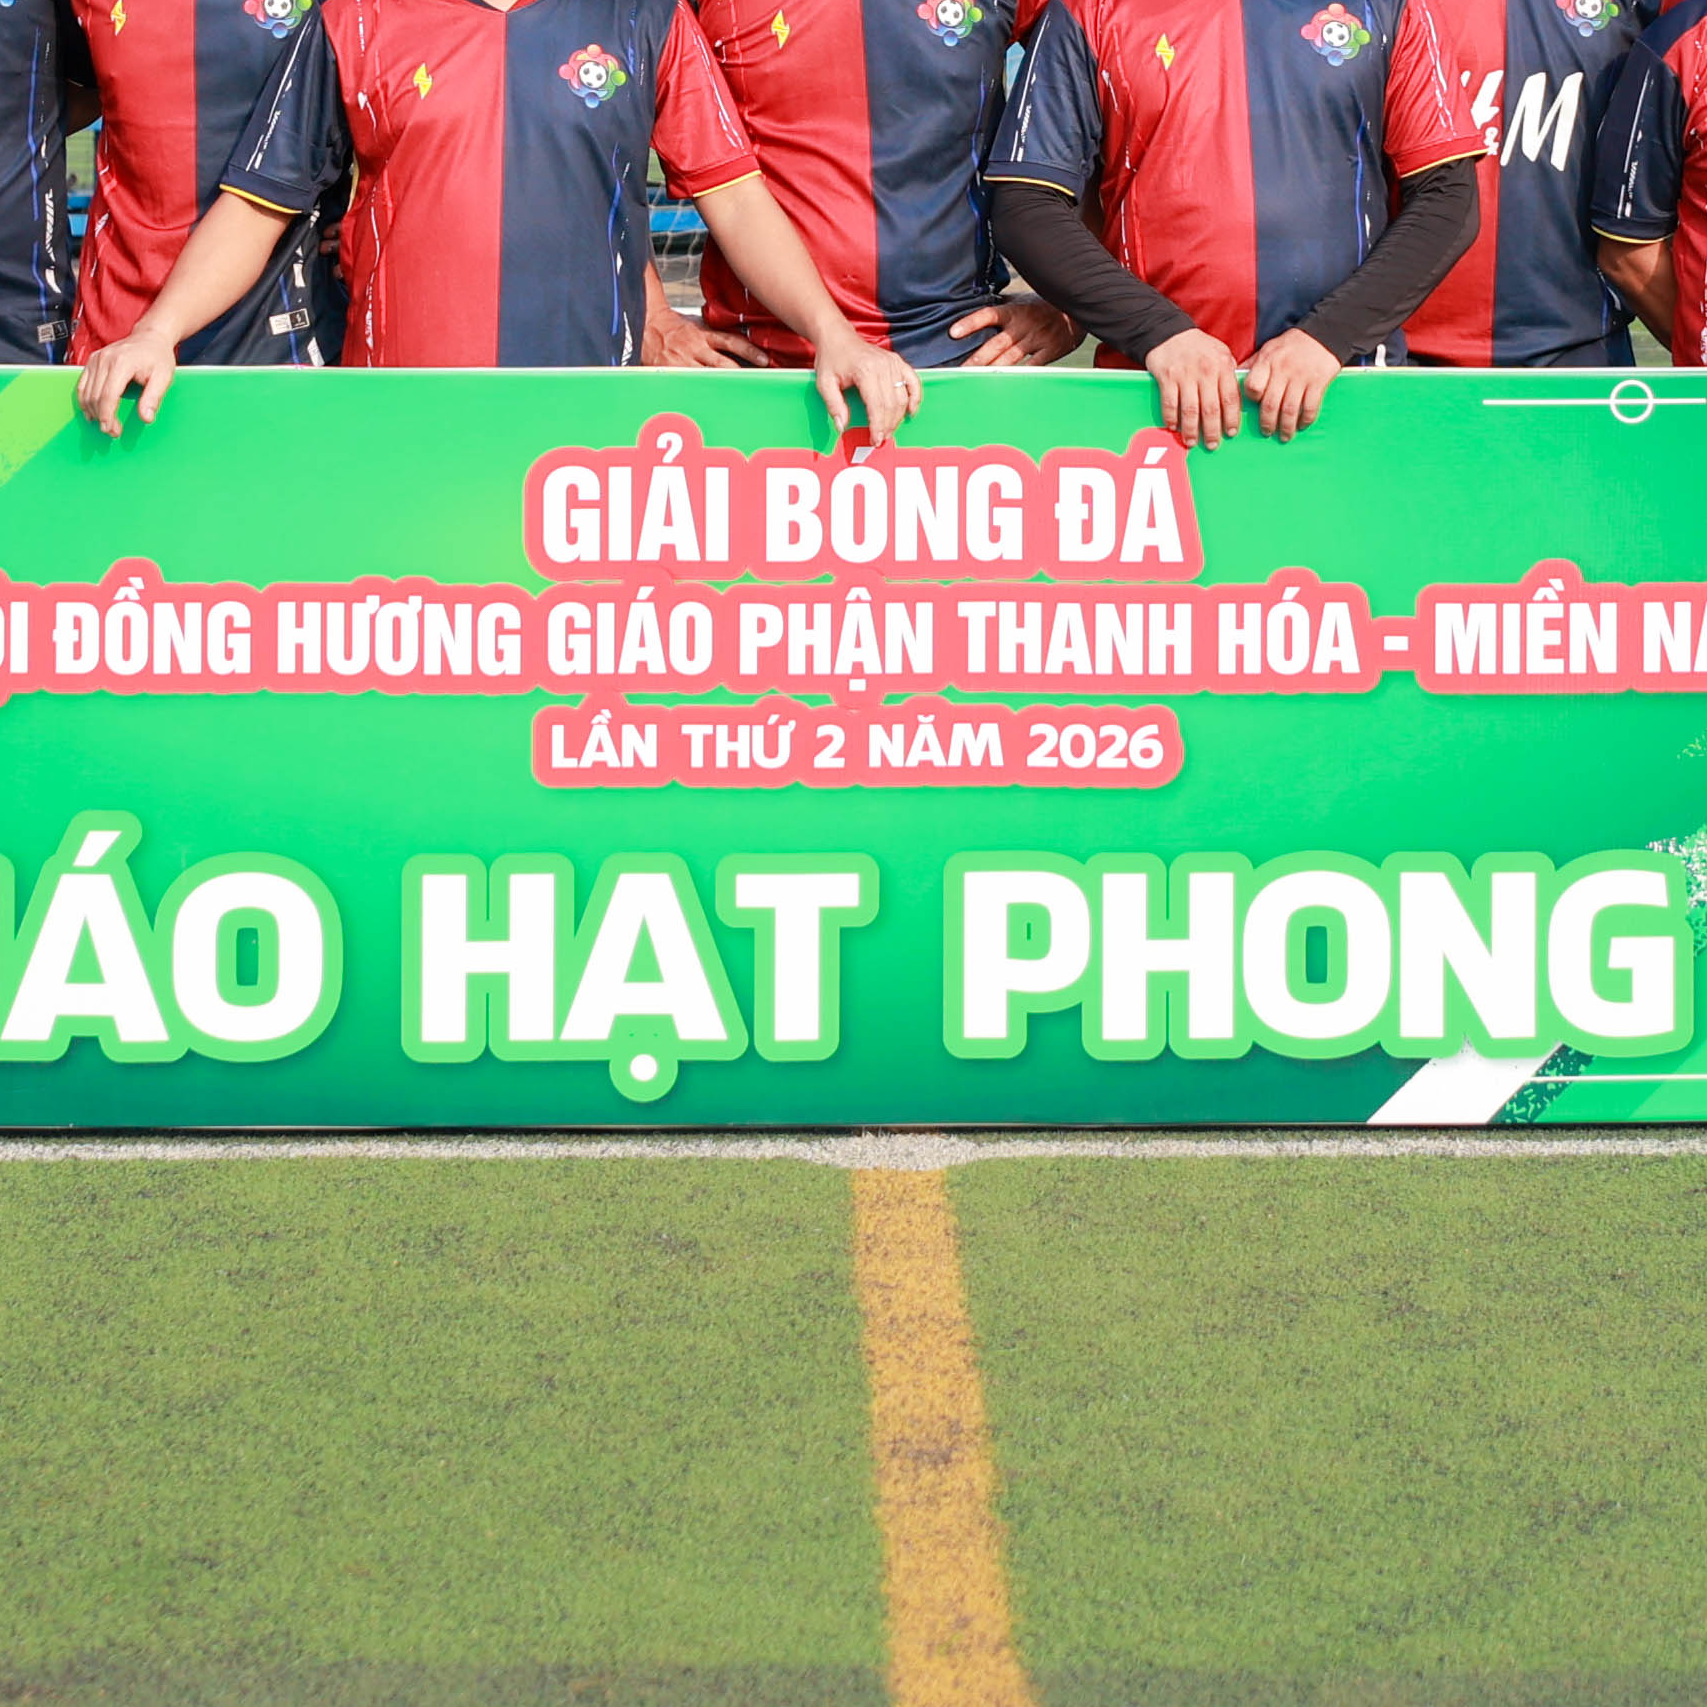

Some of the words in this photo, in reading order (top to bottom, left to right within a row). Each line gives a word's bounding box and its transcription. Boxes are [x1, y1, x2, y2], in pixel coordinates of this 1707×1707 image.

[542, 431, 730, 563] GIẢI
[765, 445, 1024, 563] BÓNG
[1054, 447, 1184, 562] ĐÁ
[52, 577, 251, 675] ĐỒNG
[277, 594, 521, 676] HƯƠNG
[547, 586, 713, 676] GIÁO
[739, 586, 933, 691] PHẬN
[957, 600, 1191, 676] THANH
[1217, 586, 1360, 675] HÓA
[1435, 578, 1617, 675] MIỀN
[551, 709, 658, 768] LẦN
[681, 714, 797, 768] THỨ
[814, 724, 845, 768] 2
[868, 714, 1004, 768] NĂM
[1027, 724, 1164, 768] 2026
[421, 872, 860, 1083] HẠT
[963, 869, 1676, 1041] PHONG
